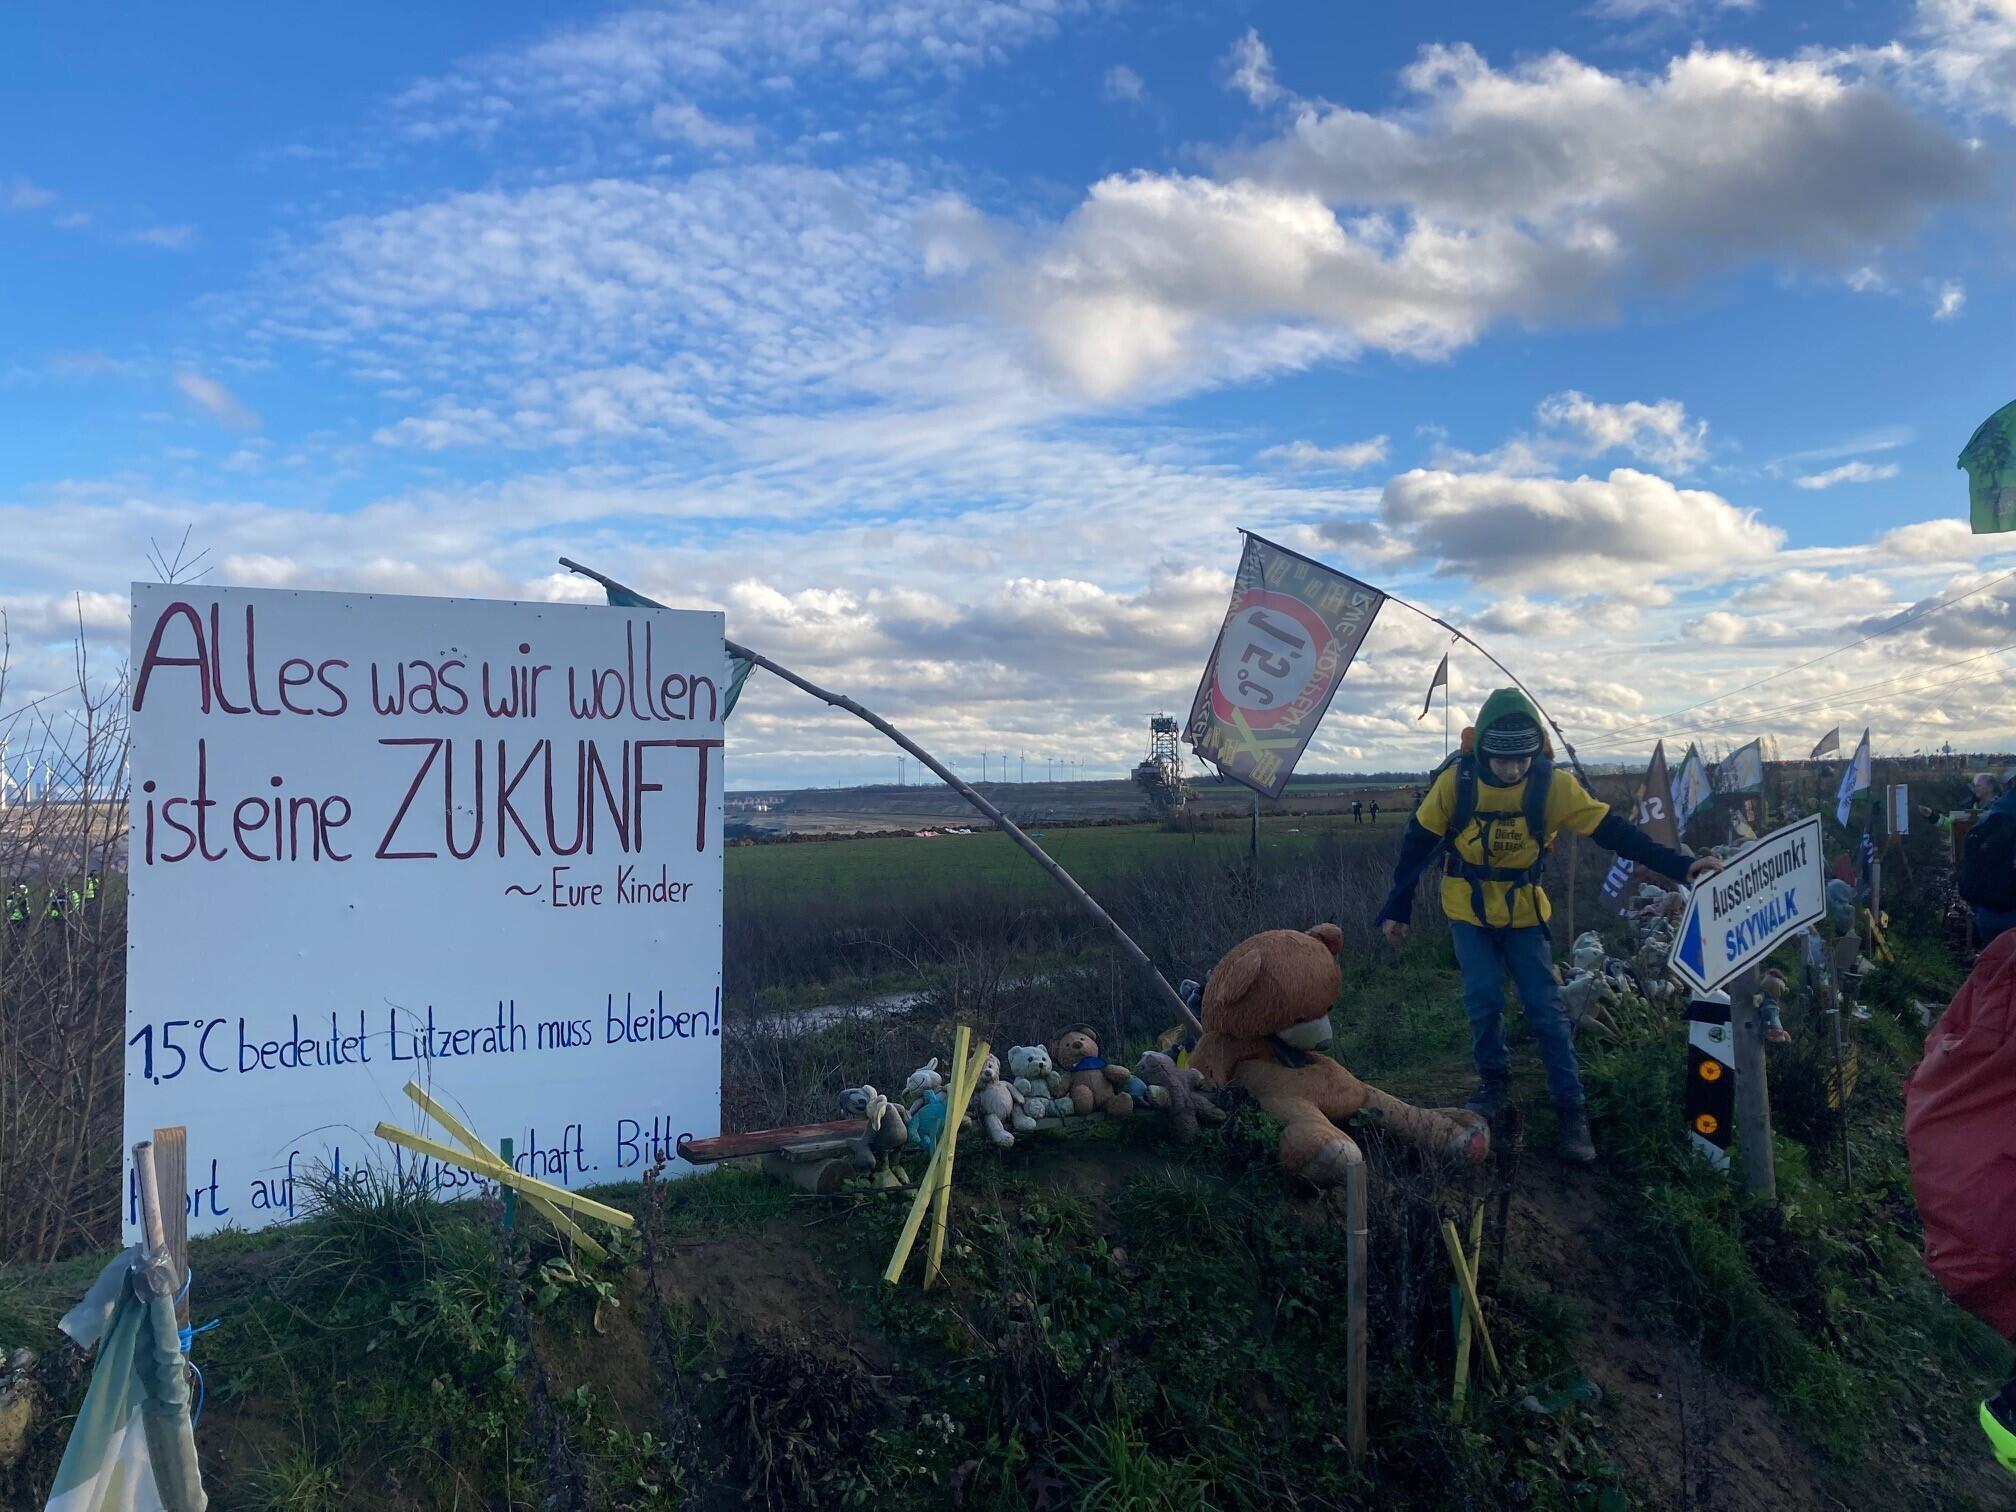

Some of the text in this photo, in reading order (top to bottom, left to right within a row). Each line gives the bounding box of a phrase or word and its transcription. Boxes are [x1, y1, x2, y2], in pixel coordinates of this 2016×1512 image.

[131, 601, 717, 722] Alles was wir wollen
[142, 737, 724, 866] ist eine ZUKUNFT
[552, 866, 603, 908] Eure
[617, 863, 694, 904] Kinder
[1712, 836, 1808, 922] Aussichtspunkt
[1725, 887, 1800, 963] SKYWALK
[238, 1009, 373, 1074] bedeutet
[390, 999, 526, 1062] Lützerath
[537, 1018, 593, 1051] muss
[606, 986, 722, 1045] bleiben!
[250, 1150, 301, 1218] auf
